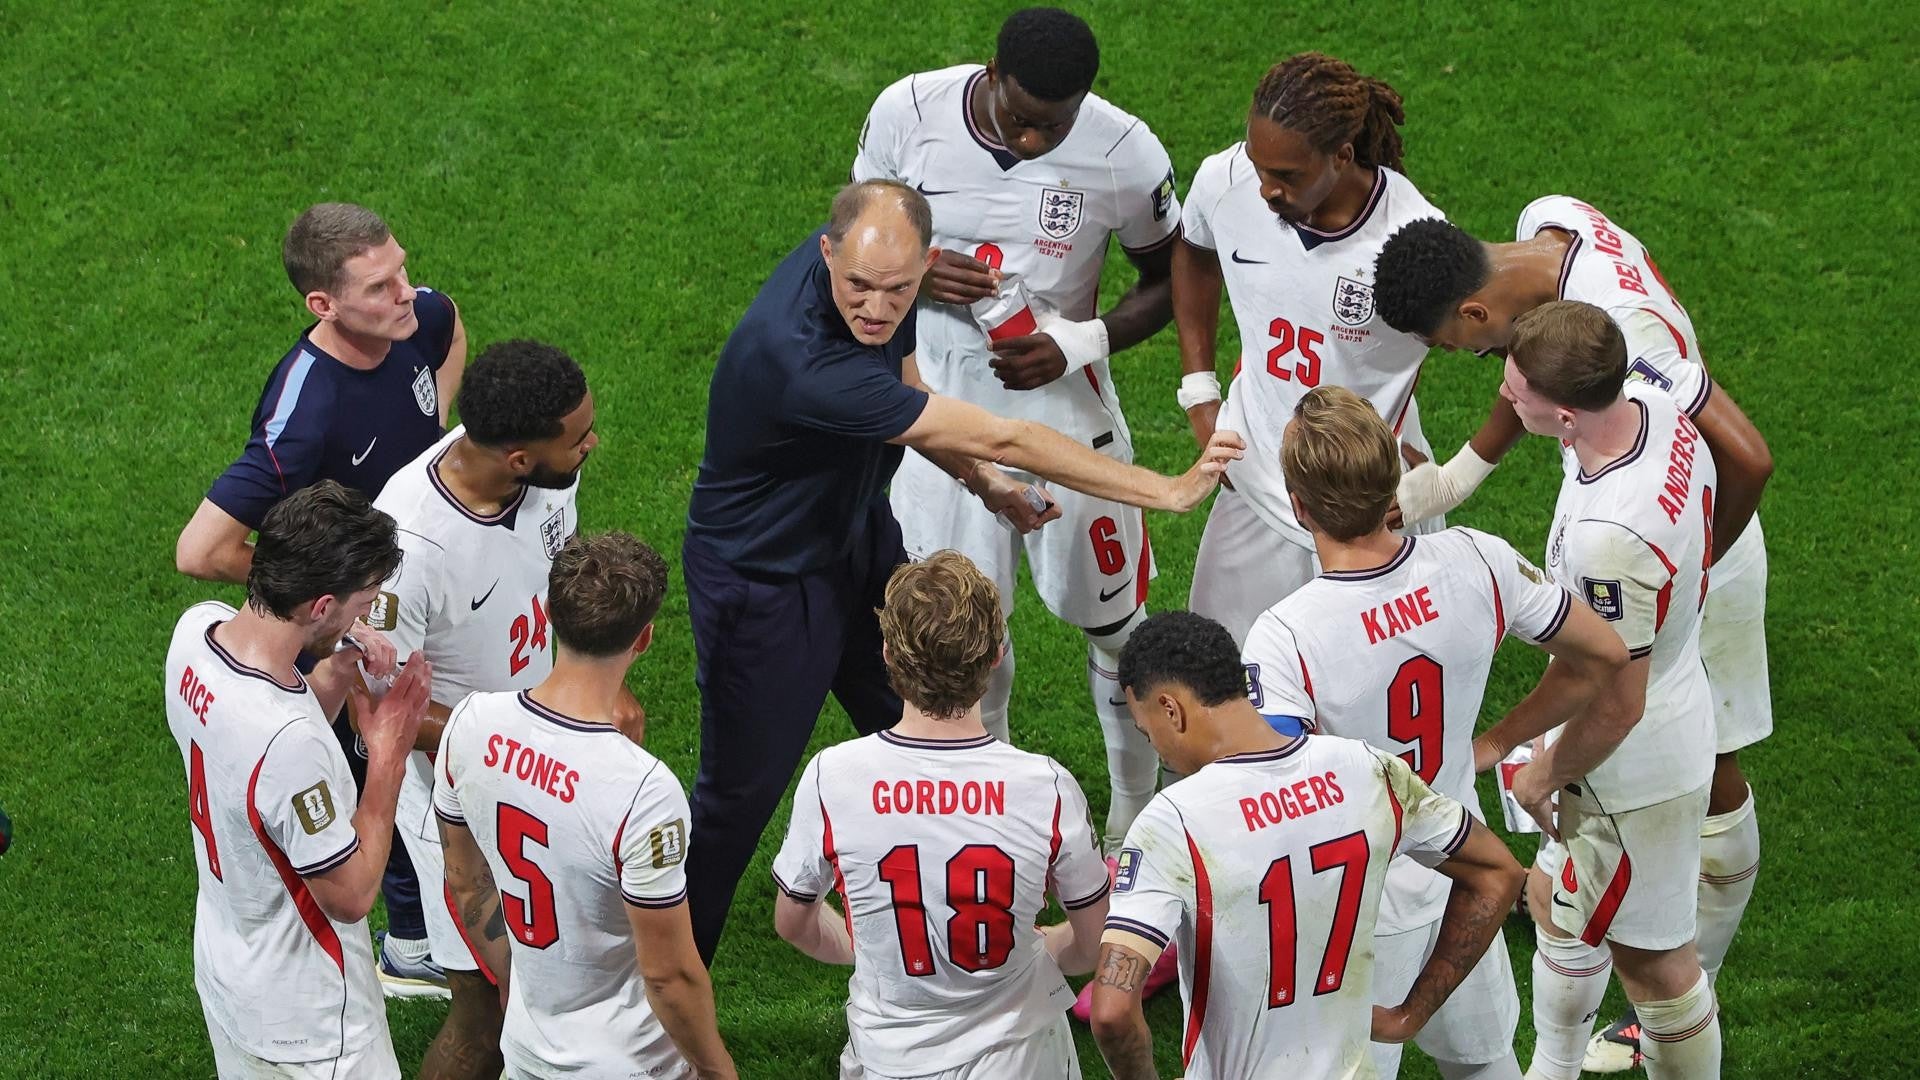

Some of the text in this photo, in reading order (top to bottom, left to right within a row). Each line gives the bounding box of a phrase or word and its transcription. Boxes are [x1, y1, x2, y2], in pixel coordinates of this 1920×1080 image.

[1033, 238, 1073, 251] ARGENTINA
[1266, 316, 1324, 389] 25
[1330, 324, 1371, 336] ARGENTINA
[1656, 402, 1698, 526] ANDERSO
[1088, 515, 1126, 577] 6
[509, 593, 548, 678] 24
[1360, 586, 1440, 645] KANE
[179, 666, 215, 727] RICE
[1387, 655, 1445, 787] 9
[484, 734, 580, 803] STONES
[872, 780, 1005, 816] GORDON
[1239, 771, 1344, 832] ROGERS
[188, 739, 223, 883] 4
[496, 802, 559, 950] 5
[878, 843, 1016, 977] 18
[1258, 829, 1370, 1010] 17
